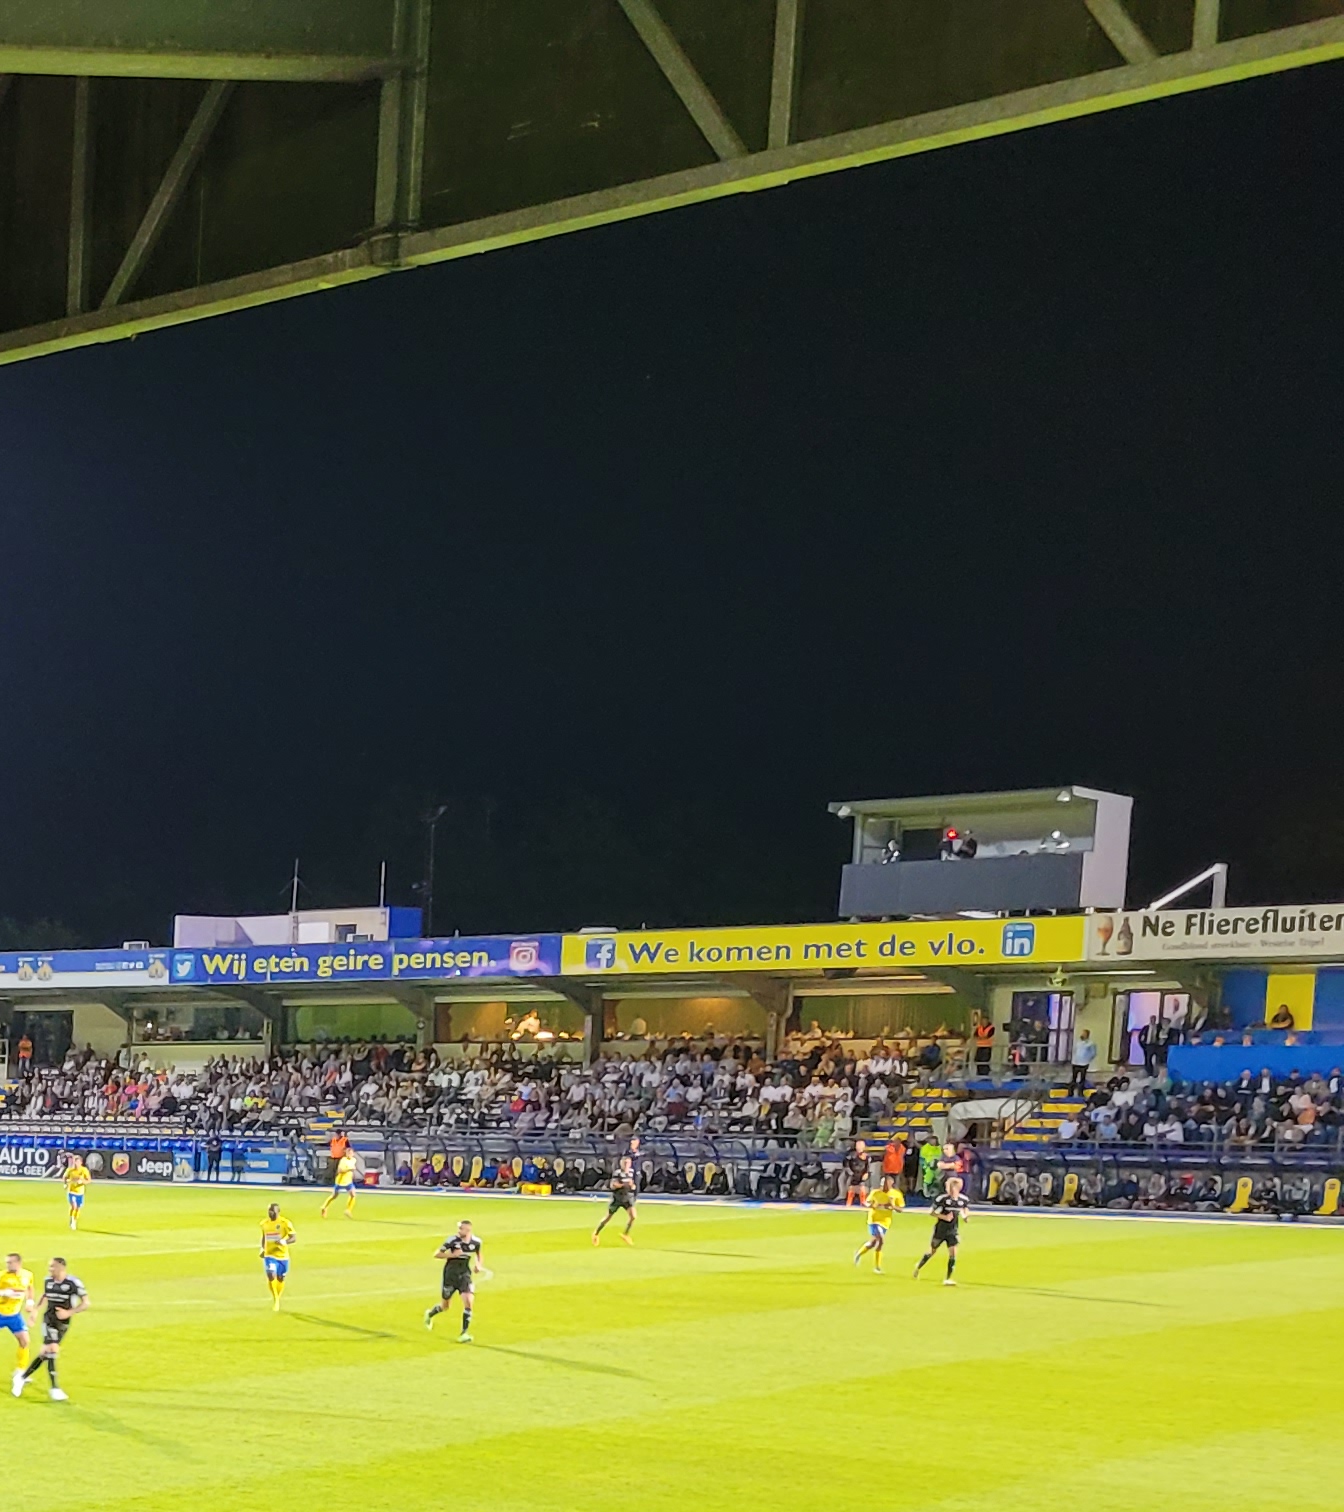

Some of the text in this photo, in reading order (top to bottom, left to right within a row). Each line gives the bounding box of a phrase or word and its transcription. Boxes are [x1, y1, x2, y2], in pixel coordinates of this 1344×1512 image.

[1141, 914, 1175, 937] Ne
[628, 932, 985, 964] We komen met de vlo.
[202, 949, 497, 980] Wij eten geire pensen.
[137, 1157, 173, 1177] Jeep
